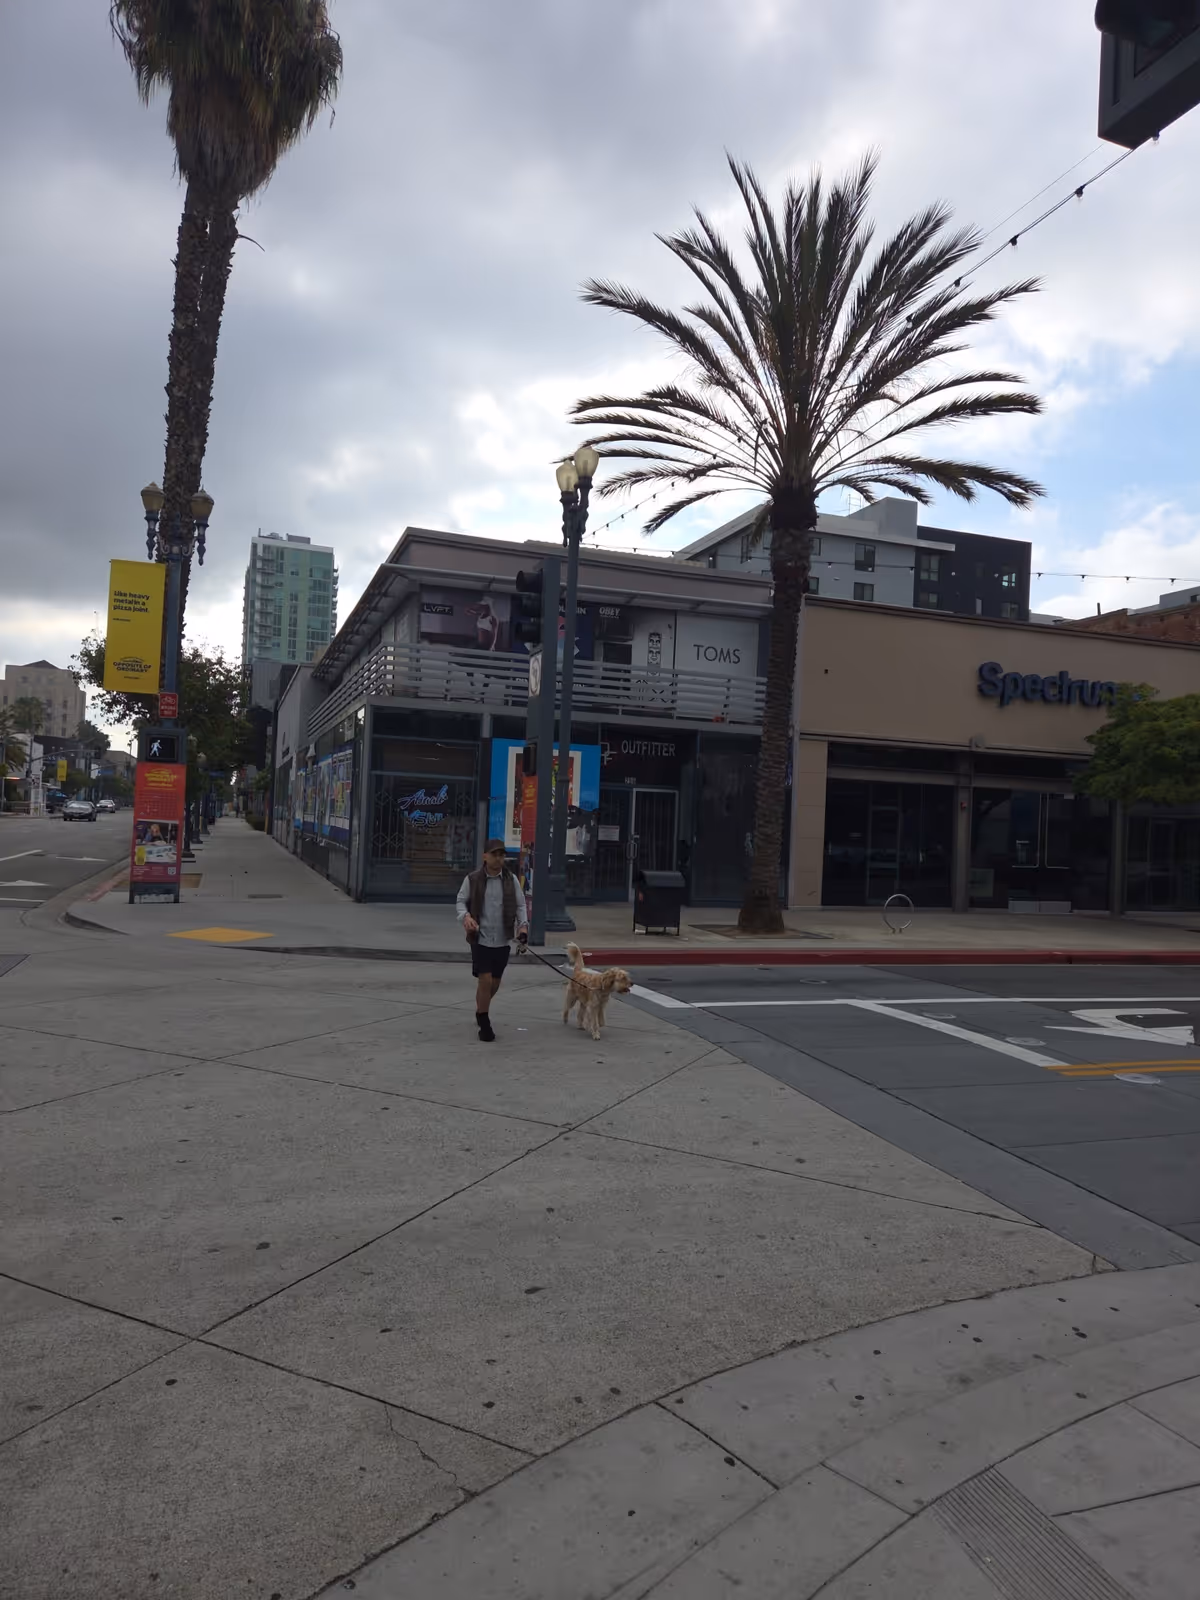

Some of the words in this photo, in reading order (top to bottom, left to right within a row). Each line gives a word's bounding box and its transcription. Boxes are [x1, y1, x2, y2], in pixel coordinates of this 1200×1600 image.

[129, 592, 150, 600] heavy
[598, 606, 621, 615] OBEY
[693, 644, 741, 664] TOMS
[113, 661, 142, 669] OPPOSITE
[621, 740, 676, 757] OUTFITTER
